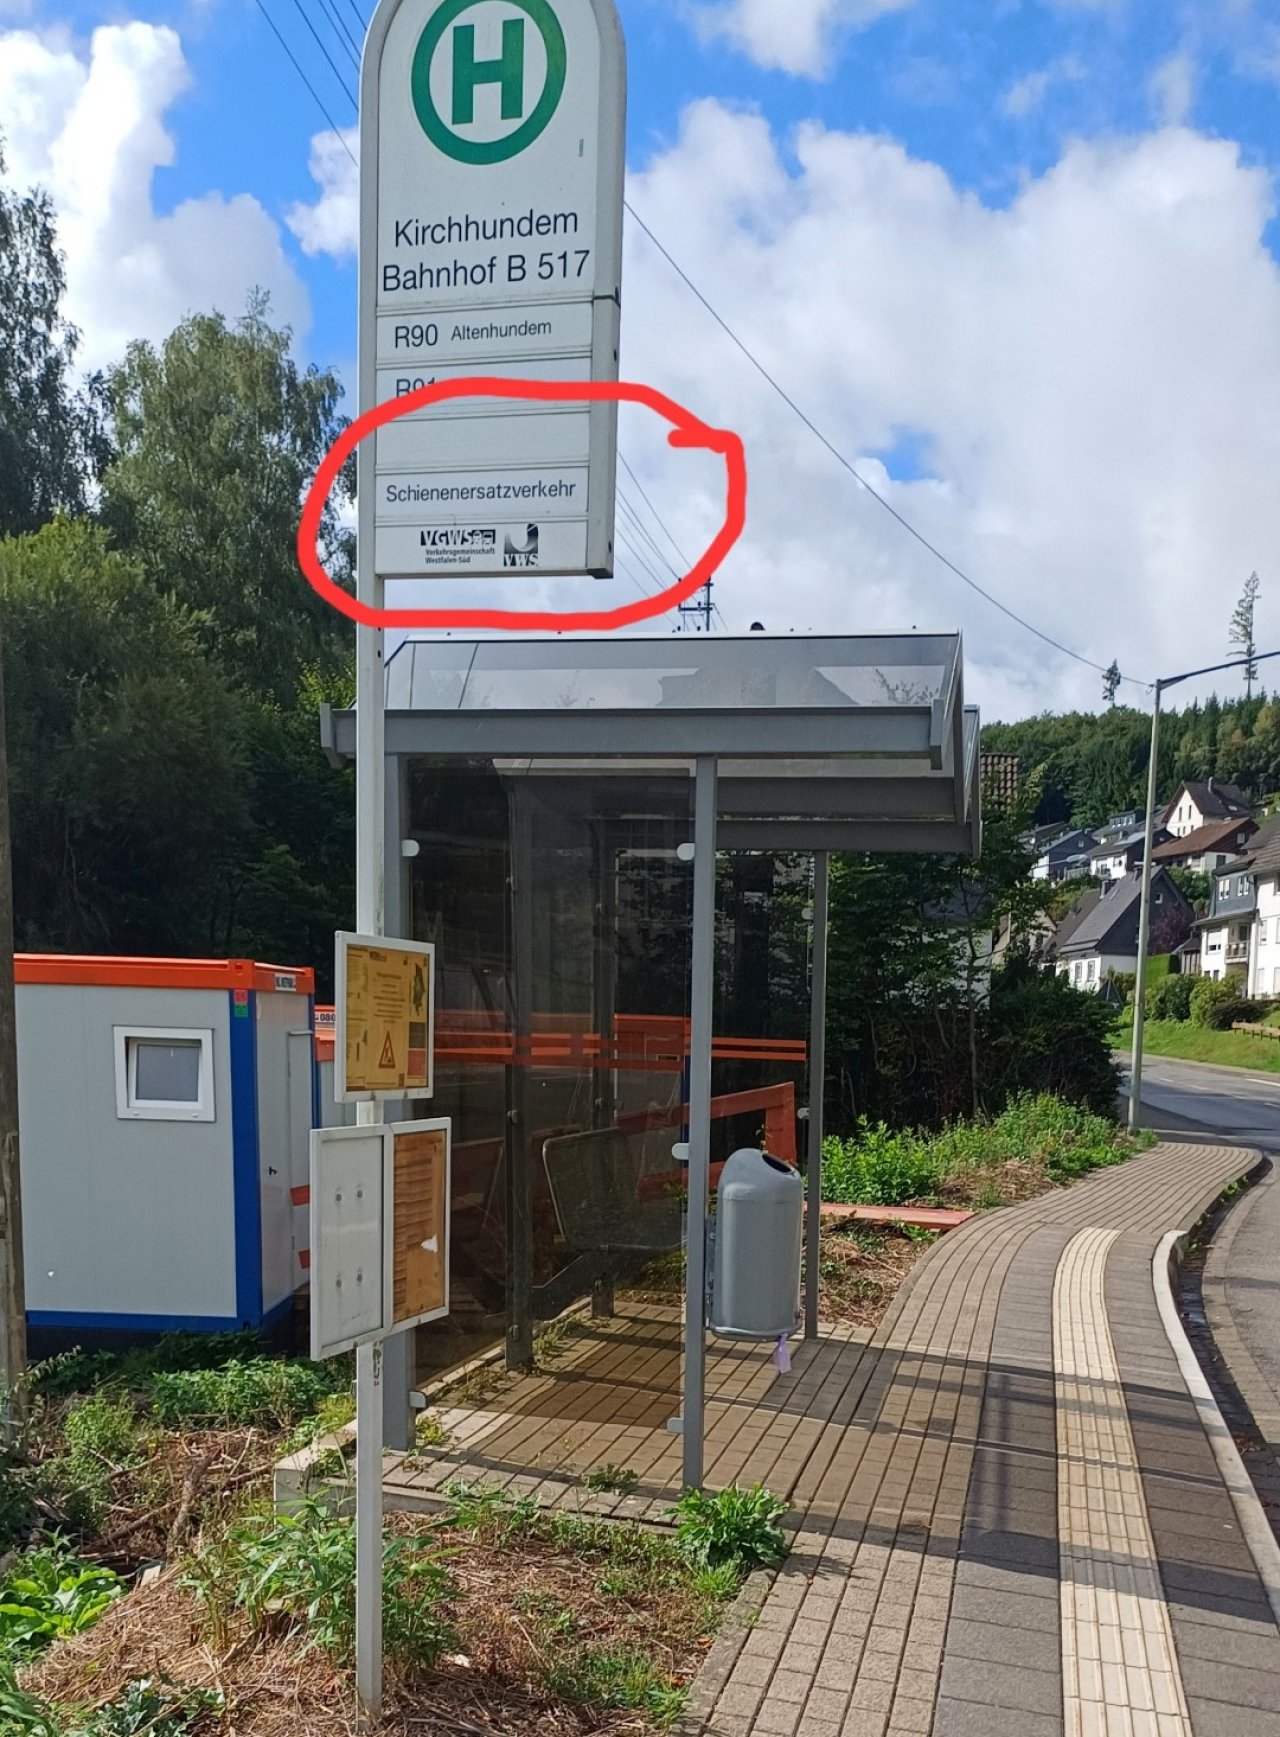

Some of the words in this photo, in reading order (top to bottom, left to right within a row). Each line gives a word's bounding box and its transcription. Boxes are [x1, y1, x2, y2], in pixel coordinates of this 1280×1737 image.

[452, 18, 524, 125] H
[394, 208, 578, 248] Kirchhundem
[383, 256, 497, 292] Bahnhof
[507, 255, 526, 282] B
[537, 249, 590, 280] 517
[395, 323, 438, 349] R90
[451, 320, 552, 341] Altenhundem
[386, 479, 577, 503] Schienenersatzverkehr
[425, 547, 496, 557] Verkehrsgemeinschaft
